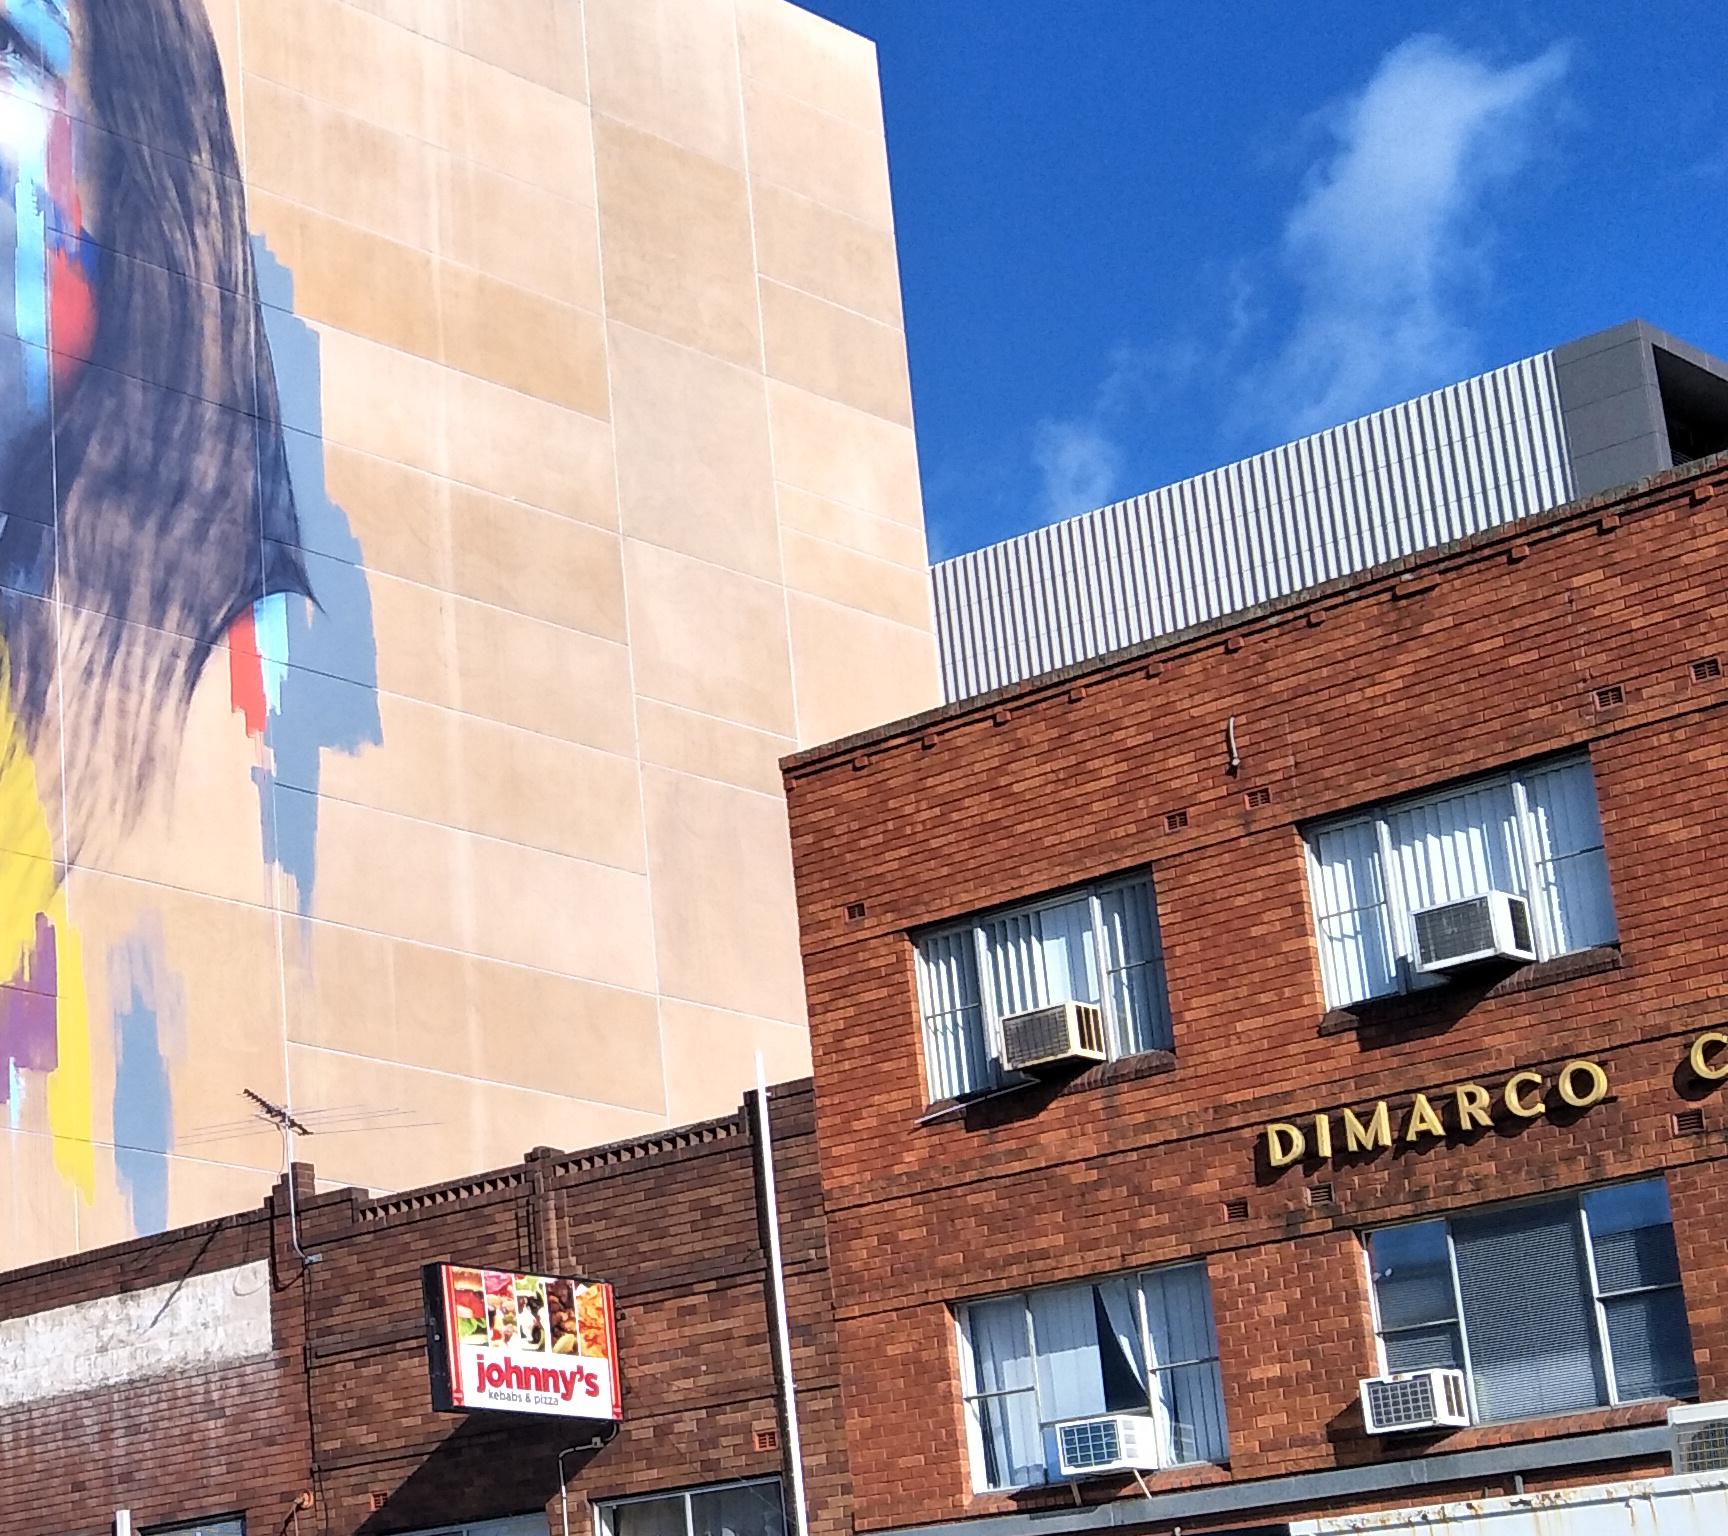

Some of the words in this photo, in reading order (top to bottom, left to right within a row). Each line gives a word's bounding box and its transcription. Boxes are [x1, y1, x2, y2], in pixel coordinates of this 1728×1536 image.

[1266, 1059, 1608, 1167] DIMARCO
[476, 1354, 600, 1401] johnny's
[488, 1390, 523, 1403] kebabs
[534, 1394, 559, 1406] pizza
